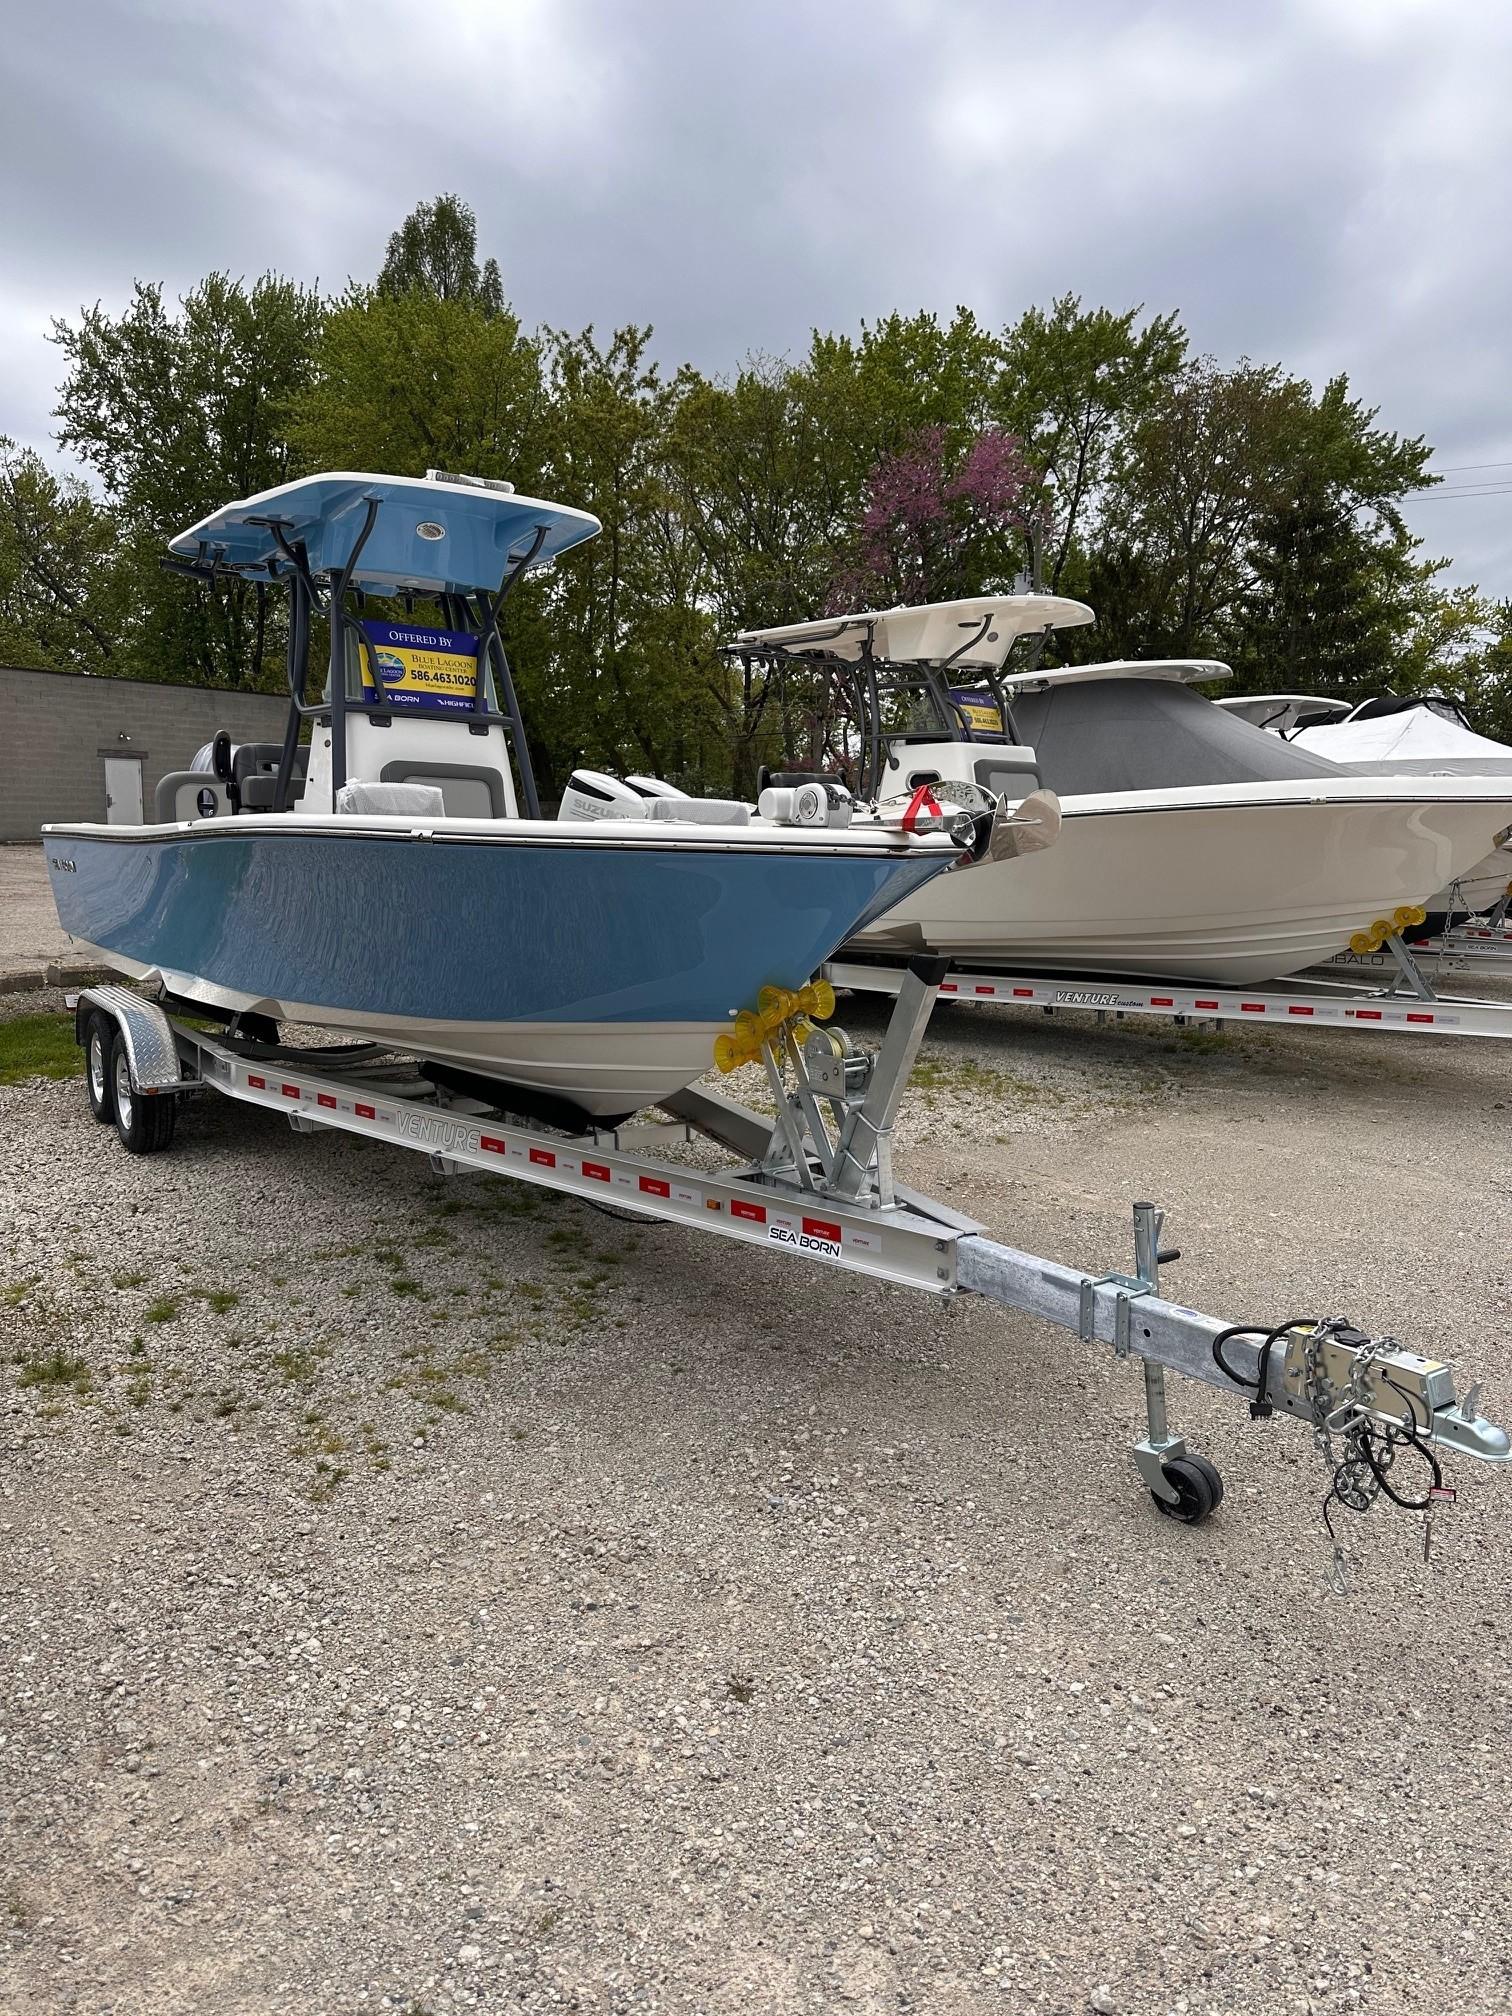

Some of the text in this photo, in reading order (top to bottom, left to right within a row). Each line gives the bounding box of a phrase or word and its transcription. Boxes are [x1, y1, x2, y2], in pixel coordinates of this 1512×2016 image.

[389, 630, 452, 647] OFFERED BY
[411, 654, 473, 669] BLUE LAGOON
[411, 669, 477, 687] 586.463.1020
[374, 693, 420, 703] SA BORN
[573, 799, 619, 819] SUZU
[1322, 953, 1384, 966] BALO
[1056, 990, 1120, 1005] VENTURE
[396, 1110, 481, 1153] VENTURE
[769, 1227, 840, 1258] SEA BORN
